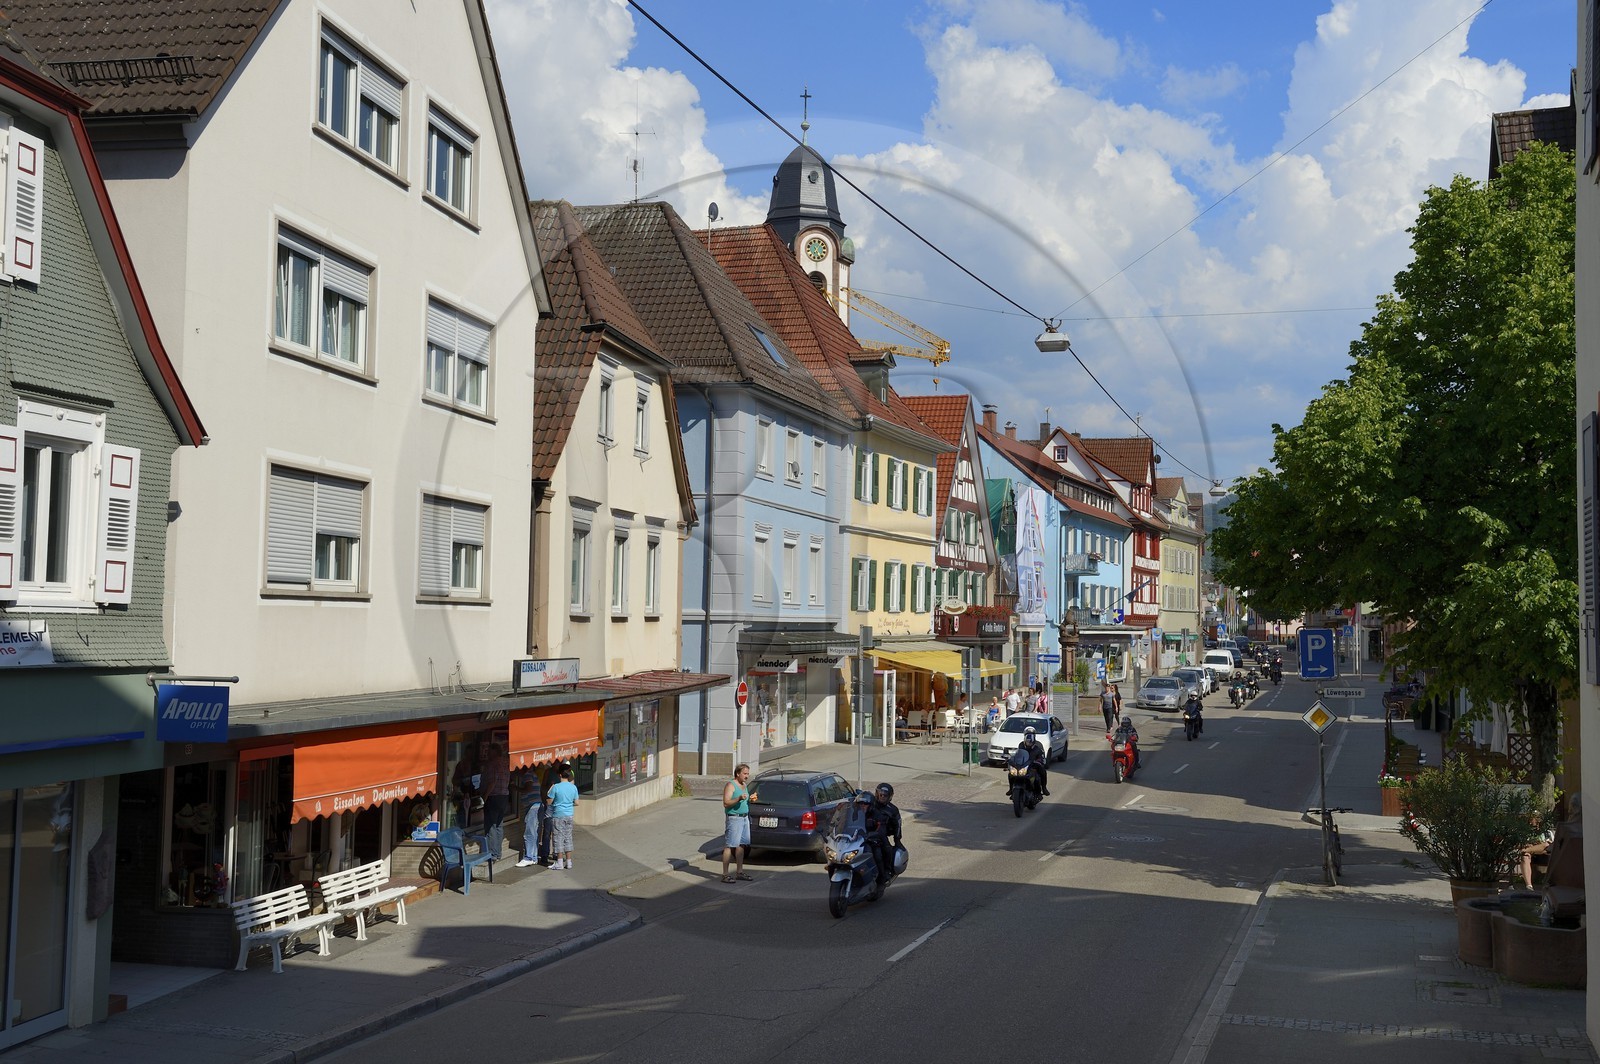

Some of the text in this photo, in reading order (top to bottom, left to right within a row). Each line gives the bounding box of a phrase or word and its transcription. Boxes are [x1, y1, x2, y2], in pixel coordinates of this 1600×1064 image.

[829, 647, 858, 656] Metzgerstraße
[1307, 634, 1327, 662] P
[757, 659, 790, 668] niendorf
[807, 656, 838, 665] niendorf
[521, 662, 547, 673] EISSALON
[541, 668, 569, 685] Dolomiten
[1326, 688, 1362, 698] Löwengasse
[161, 698, 224, 721] APOLLO
[190, 721, 216, 729] OPTIK
[532, 745, 579, 763] Eissalon Dolomiten
[333, 785, 408, 811] Eissalon Dolomiten
